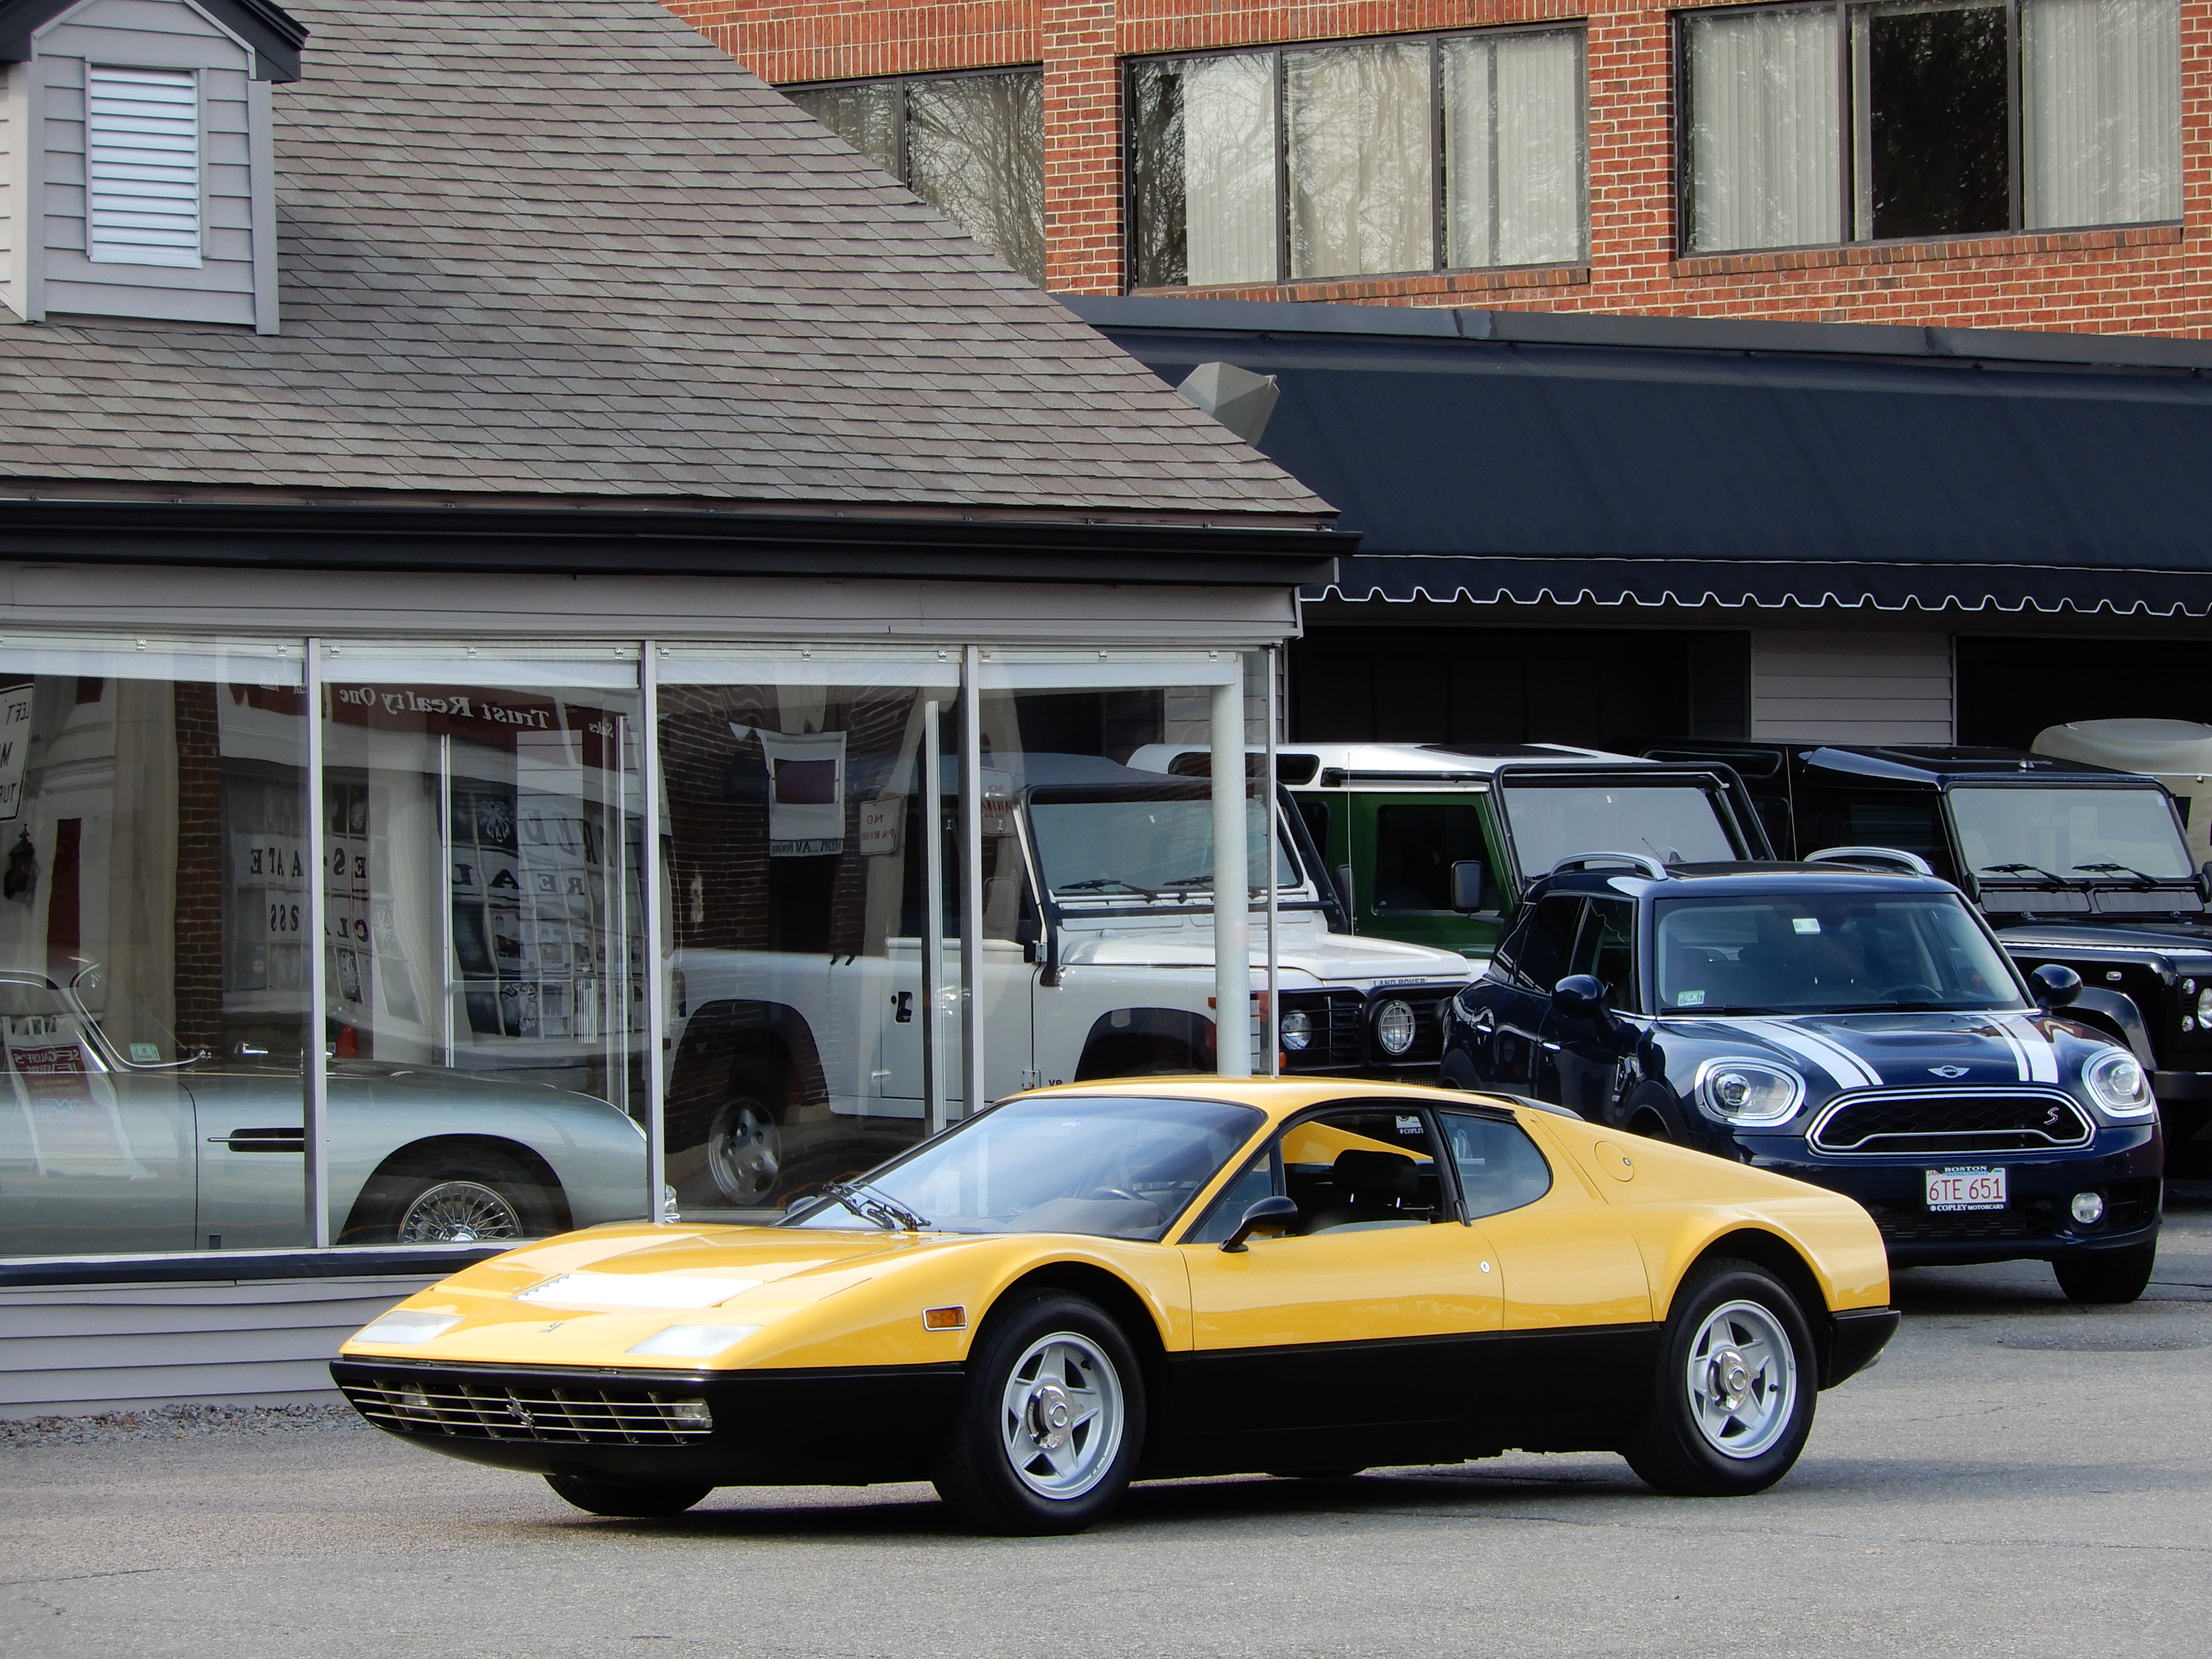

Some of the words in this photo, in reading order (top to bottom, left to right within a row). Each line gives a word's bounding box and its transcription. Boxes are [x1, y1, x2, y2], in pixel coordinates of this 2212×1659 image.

[2043, 1107, 2060, 1125] S
[1929, 1179, 1963, 1201] 6TE
[1969, 1178, 2003, 1200] 651
